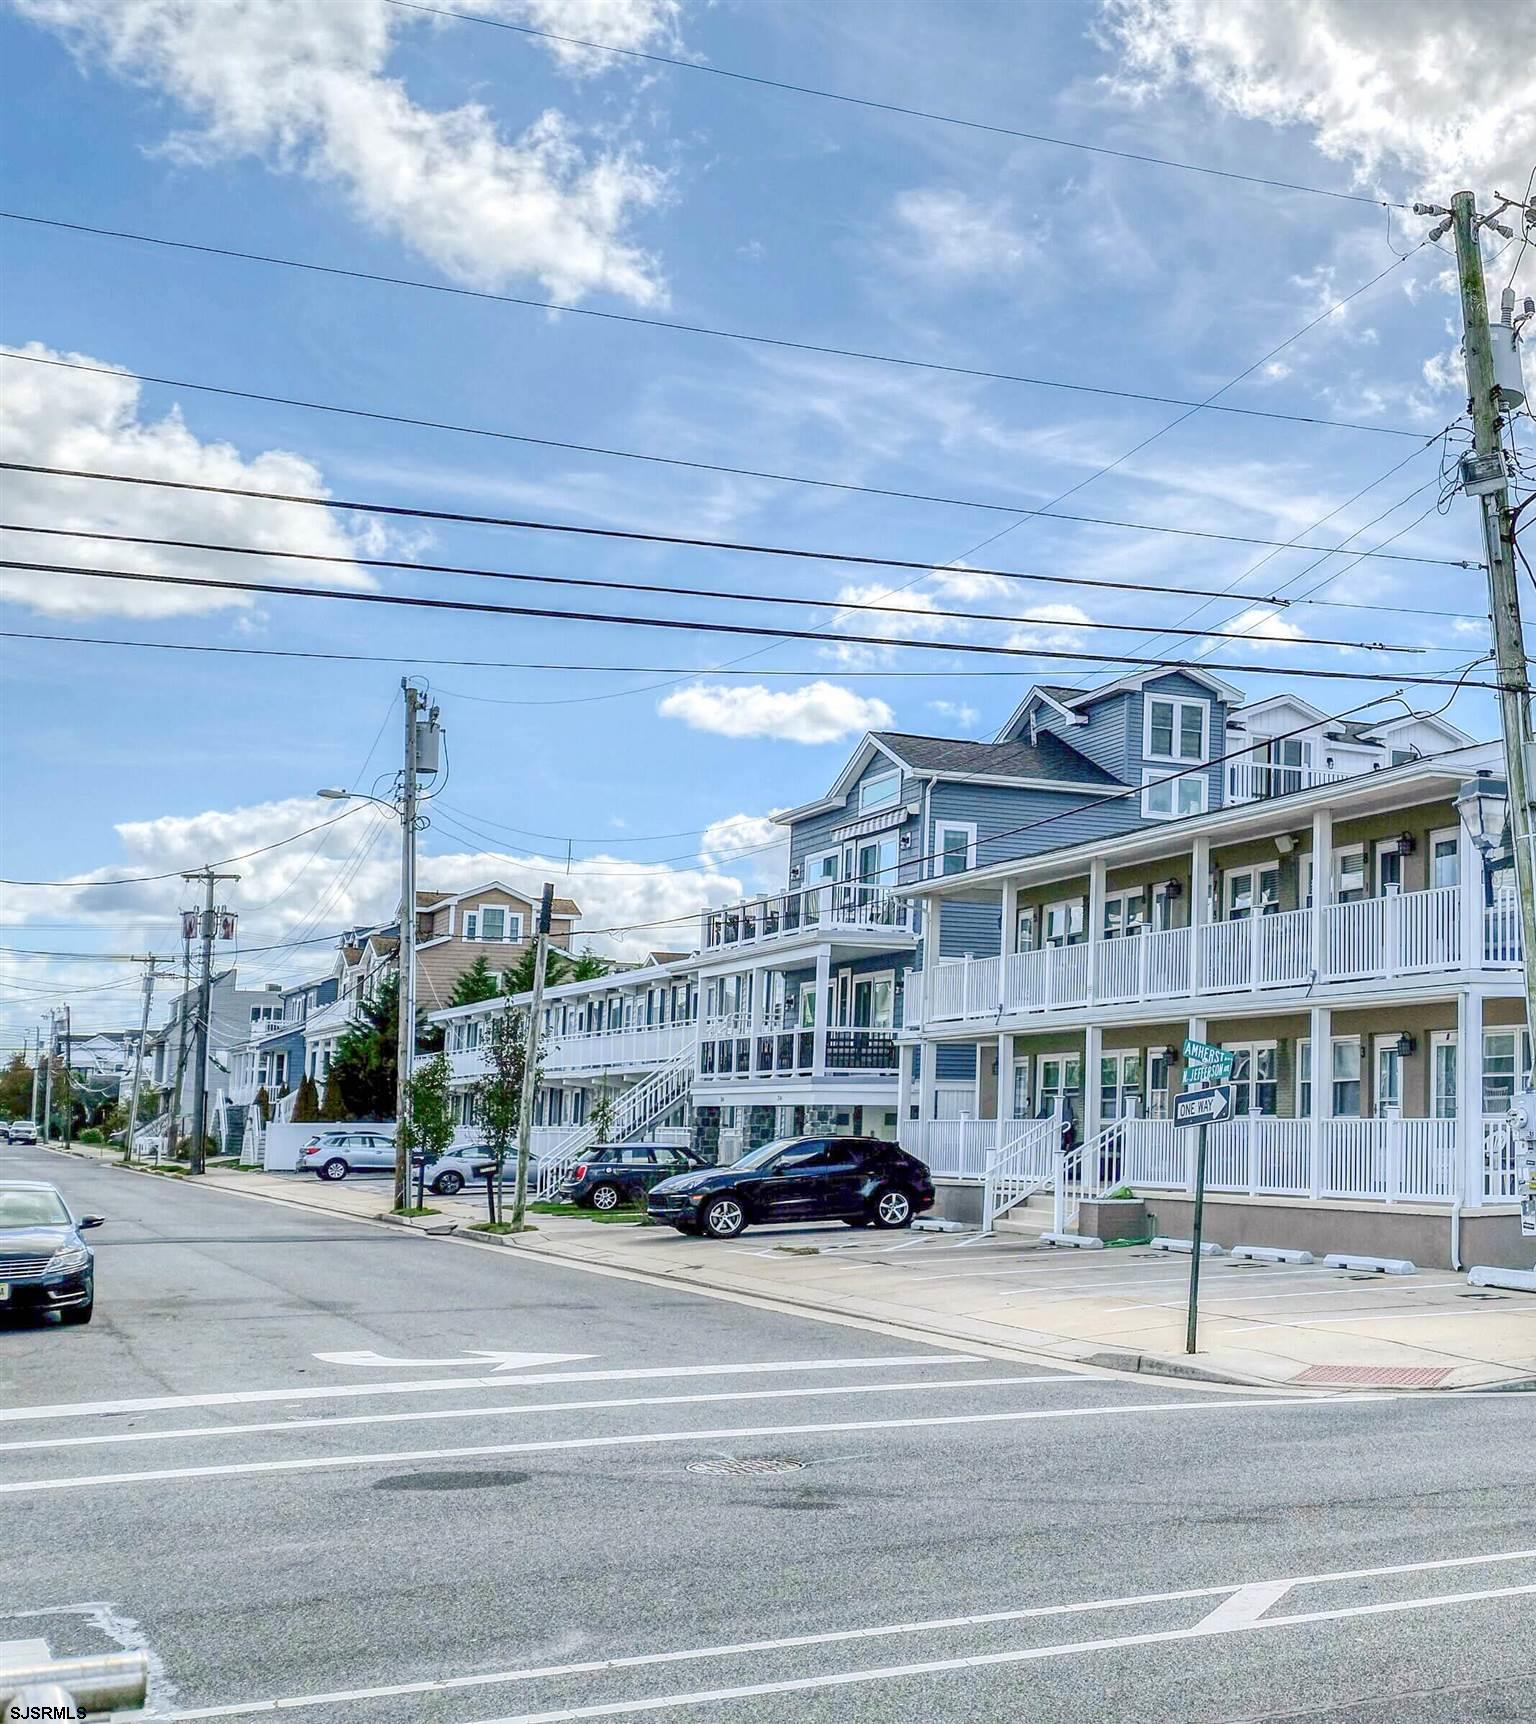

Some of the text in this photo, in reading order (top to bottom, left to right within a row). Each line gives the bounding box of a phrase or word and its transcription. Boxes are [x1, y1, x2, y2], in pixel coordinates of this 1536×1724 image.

[1184, 1042, 1225, 1063] AMHERST
[1360, 1046, 1366, 1058] 3
[1189, 1063, 1224, 1082] JEFFERSON
[1180, 1099, 1213, 1117] ONE WAY
